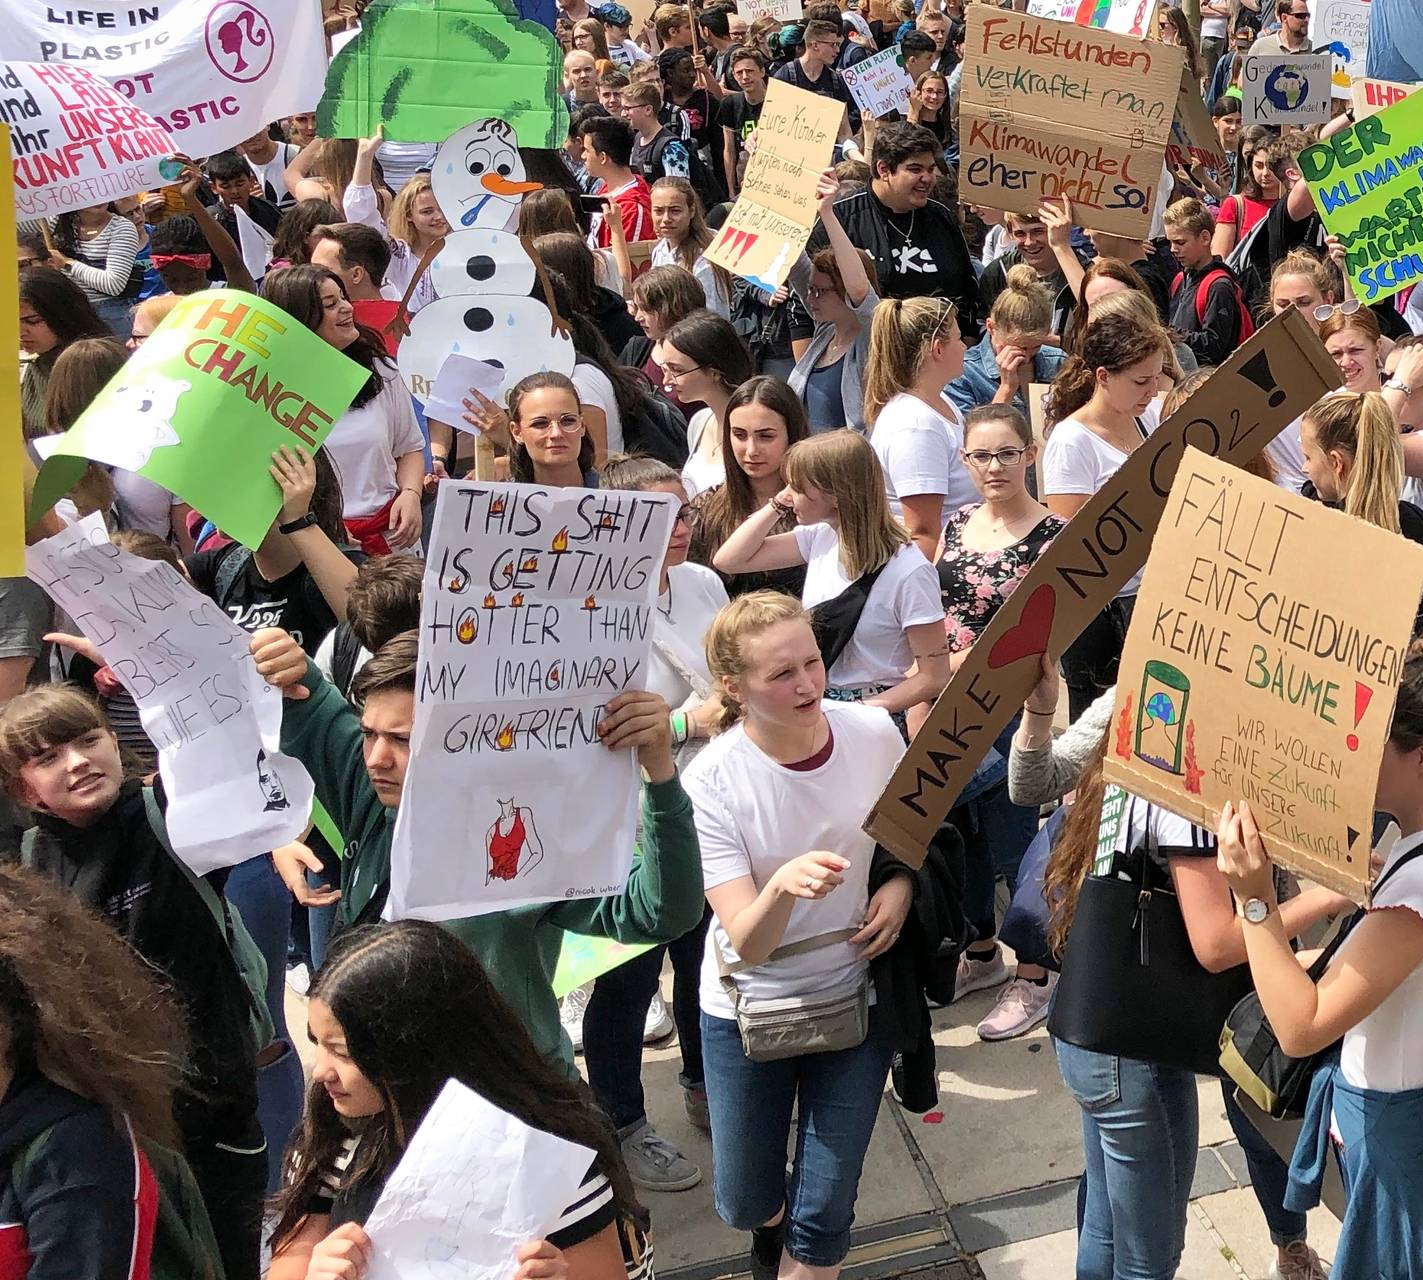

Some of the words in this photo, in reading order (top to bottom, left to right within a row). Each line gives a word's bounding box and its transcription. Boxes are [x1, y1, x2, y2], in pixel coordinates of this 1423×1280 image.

[47, 7, 116, 28] LIFE
[128, 7, 159, 27] IN
[40, 31, 171, 62] PLASTIC
[982, 18, 1152, 74] Fehlstunden
[0, 65, 23, 91] nd
[29, 63, 103, 87] HIER
[48, 83, 135, 112] LAUT
[114, 73, 155, 99] OT
[60, 107, 160, 143] UNSERE
[153, 96, 241, 134] STIC
[1101, 88, 1166, 126] man,
[11, 138, 108, 190] KUNFT
[969, 119, 1138, 185] Klimawandel
[1296, 114, 1392, 183] DER
[78, 164, 152, 200] FUTURE
[967, 153, 1037, 190] eher
[1041, 167, 1106, 203] nicht
[183, 338, 334, 448] CHANGE
[457, 488, 549, 537] THIS
[1174, 471, 1306, 577] FÄLLT
[438, 546, 473, 594] IS
[489, 547, 652, 594] GETTING
[427, 600, 560, 646] HOTTER
[579, 604, 651, 643] THAN
[1151, 601, 1234, 674] KEINE
[1183, 556, 1408, 689] ENTSCHEIDUNGEN
[900, 673, 1000, 818] MAKE
[1055, 490, 1144, 599] NOT
[420, 660, 467, 703] MY
[494, 656, 640, 698] IMAGINARY
[1236, 713, 1267, 746] WIR
[1272, 730, 1343, 780] WOLLEN
[1210, 759, 1236, 790] für
[1218, 736, 1262, 780] EINE
[1267, 756, 1342, 811] Zukunft
[1101, 797, 1123, 822] EHT
